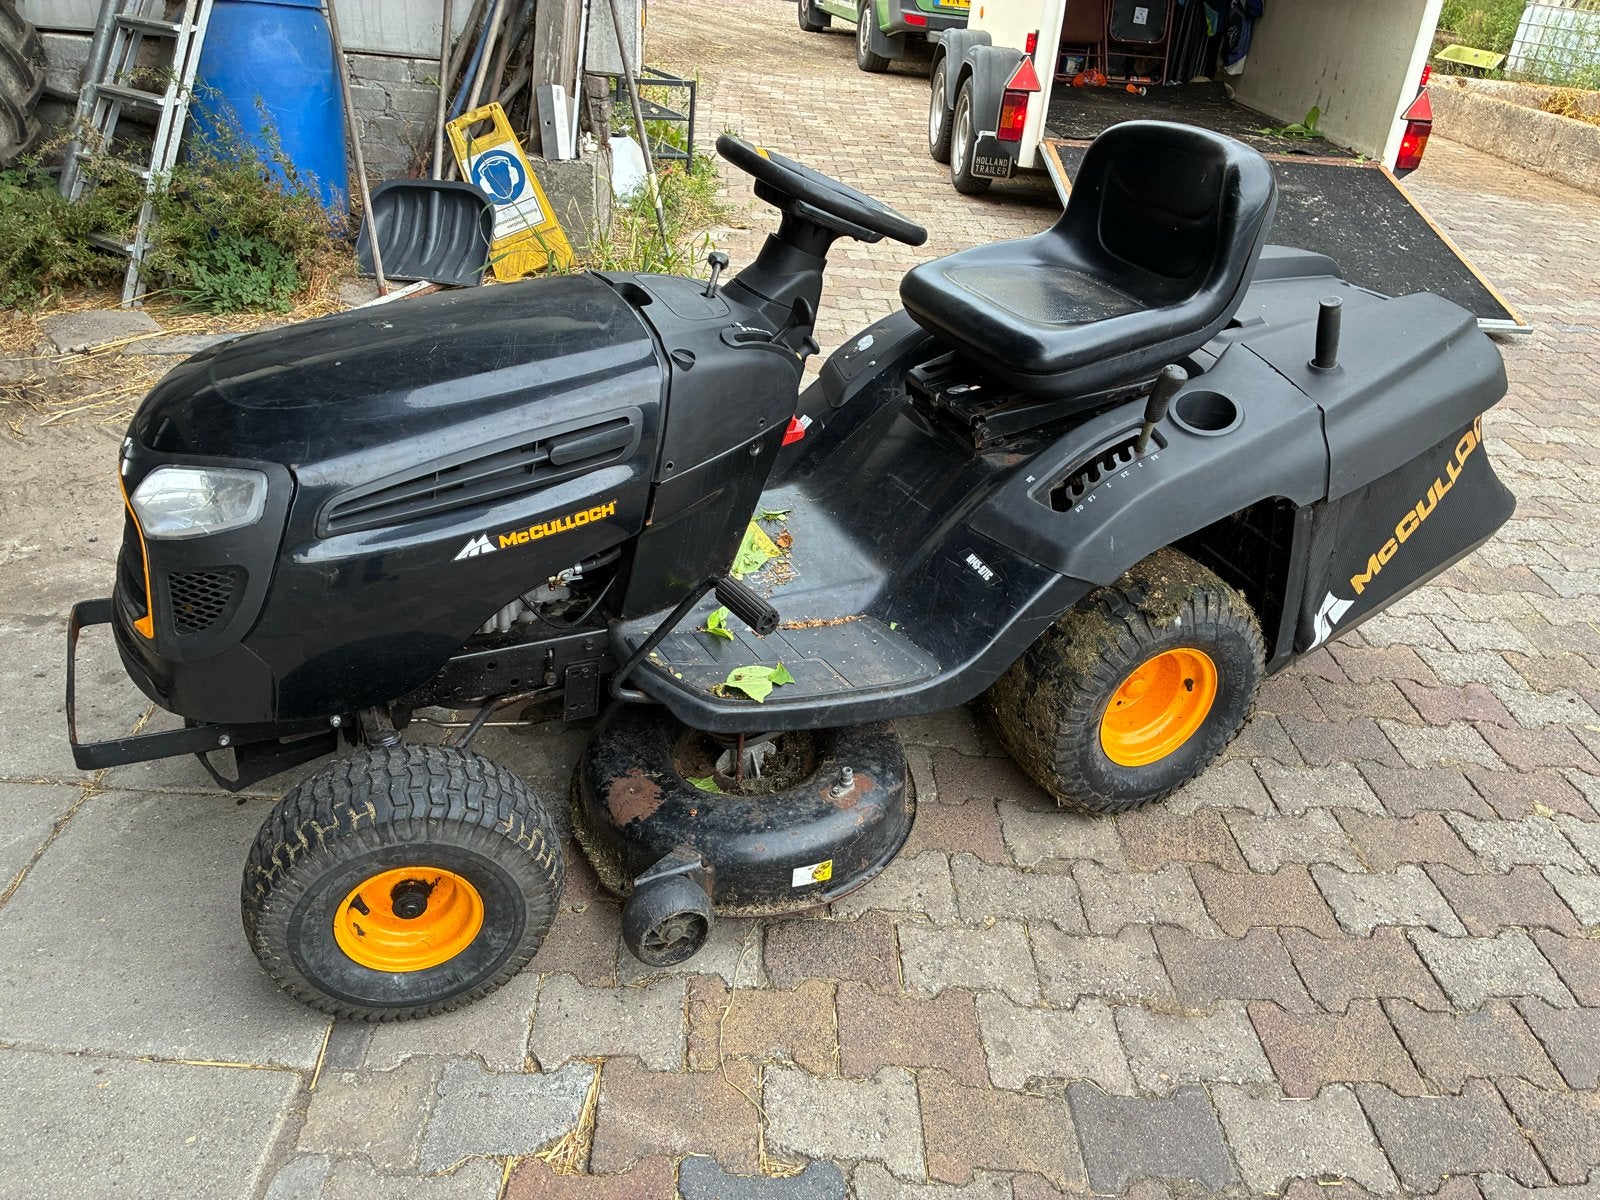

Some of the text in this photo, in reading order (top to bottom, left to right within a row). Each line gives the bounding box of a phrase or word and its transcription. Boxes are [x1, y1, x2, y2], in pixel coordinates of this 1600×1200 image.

[975, 156, 1008, 167] HOLLAND
[975, 164, 1007, 175] TRAILER
[499, 502, 615, 549] McCULLOCH
